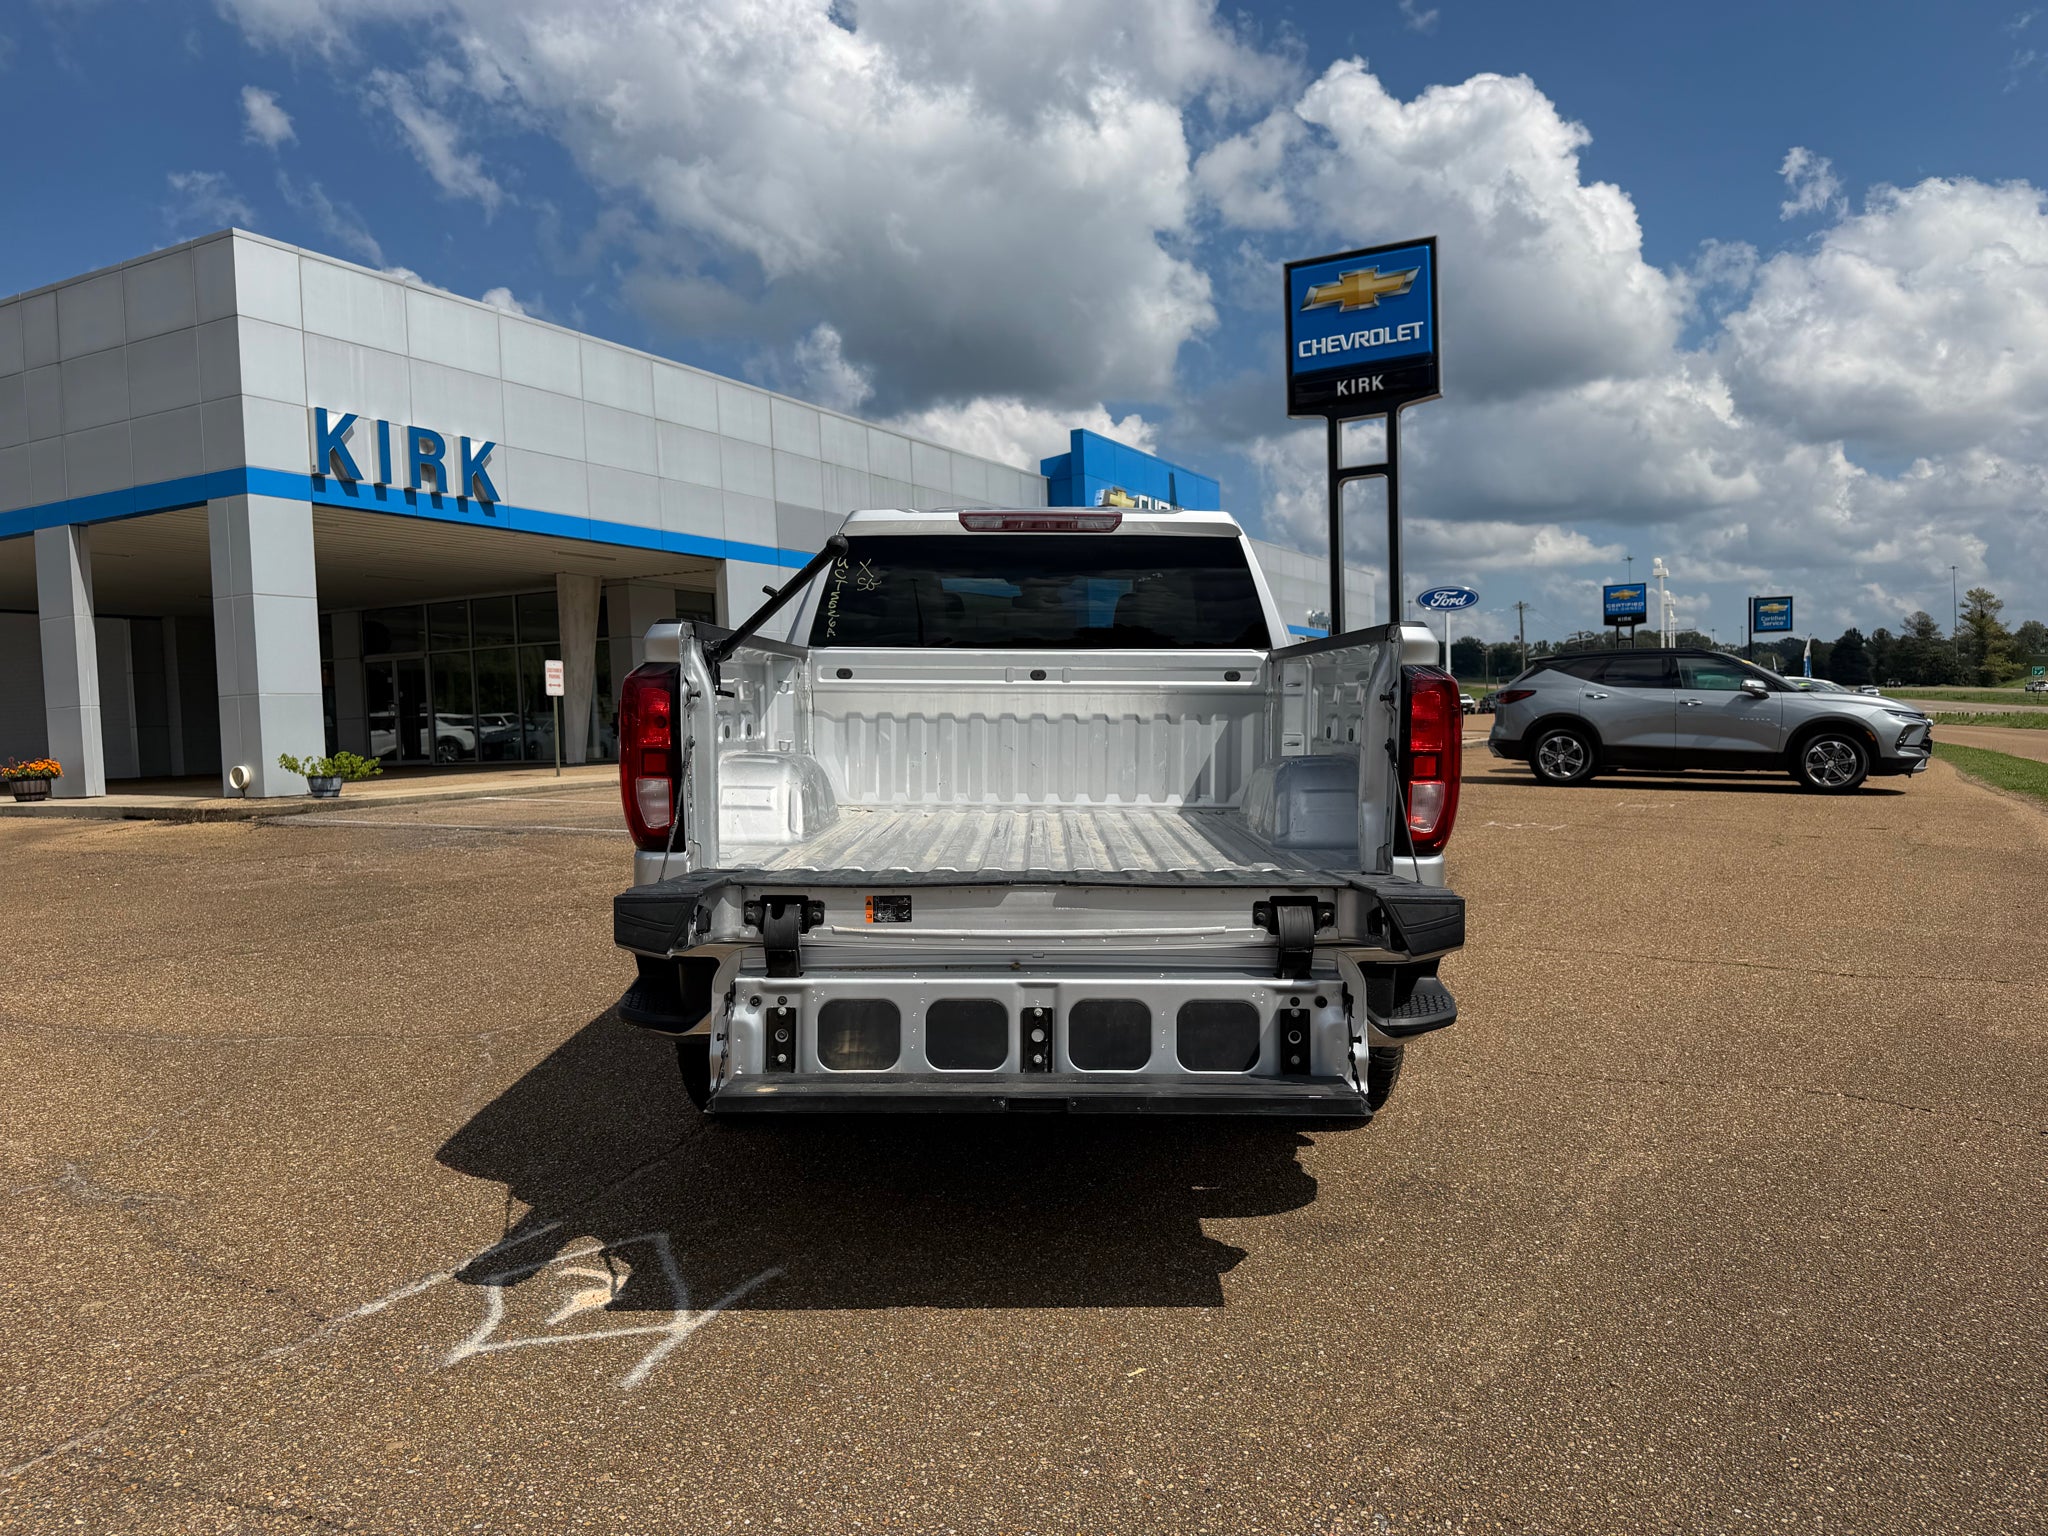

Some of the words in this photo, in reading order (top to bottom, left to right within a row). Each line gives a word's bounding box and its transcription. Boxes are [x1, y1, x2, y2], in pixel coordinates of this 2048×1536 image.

[1298, 321, 1424, 358] CHEVROLET
[1336, 374, 1385, 397] KIRK
[309, 406, 501, 502] KIRK
[1430, 591, 1468, 607] Ford
